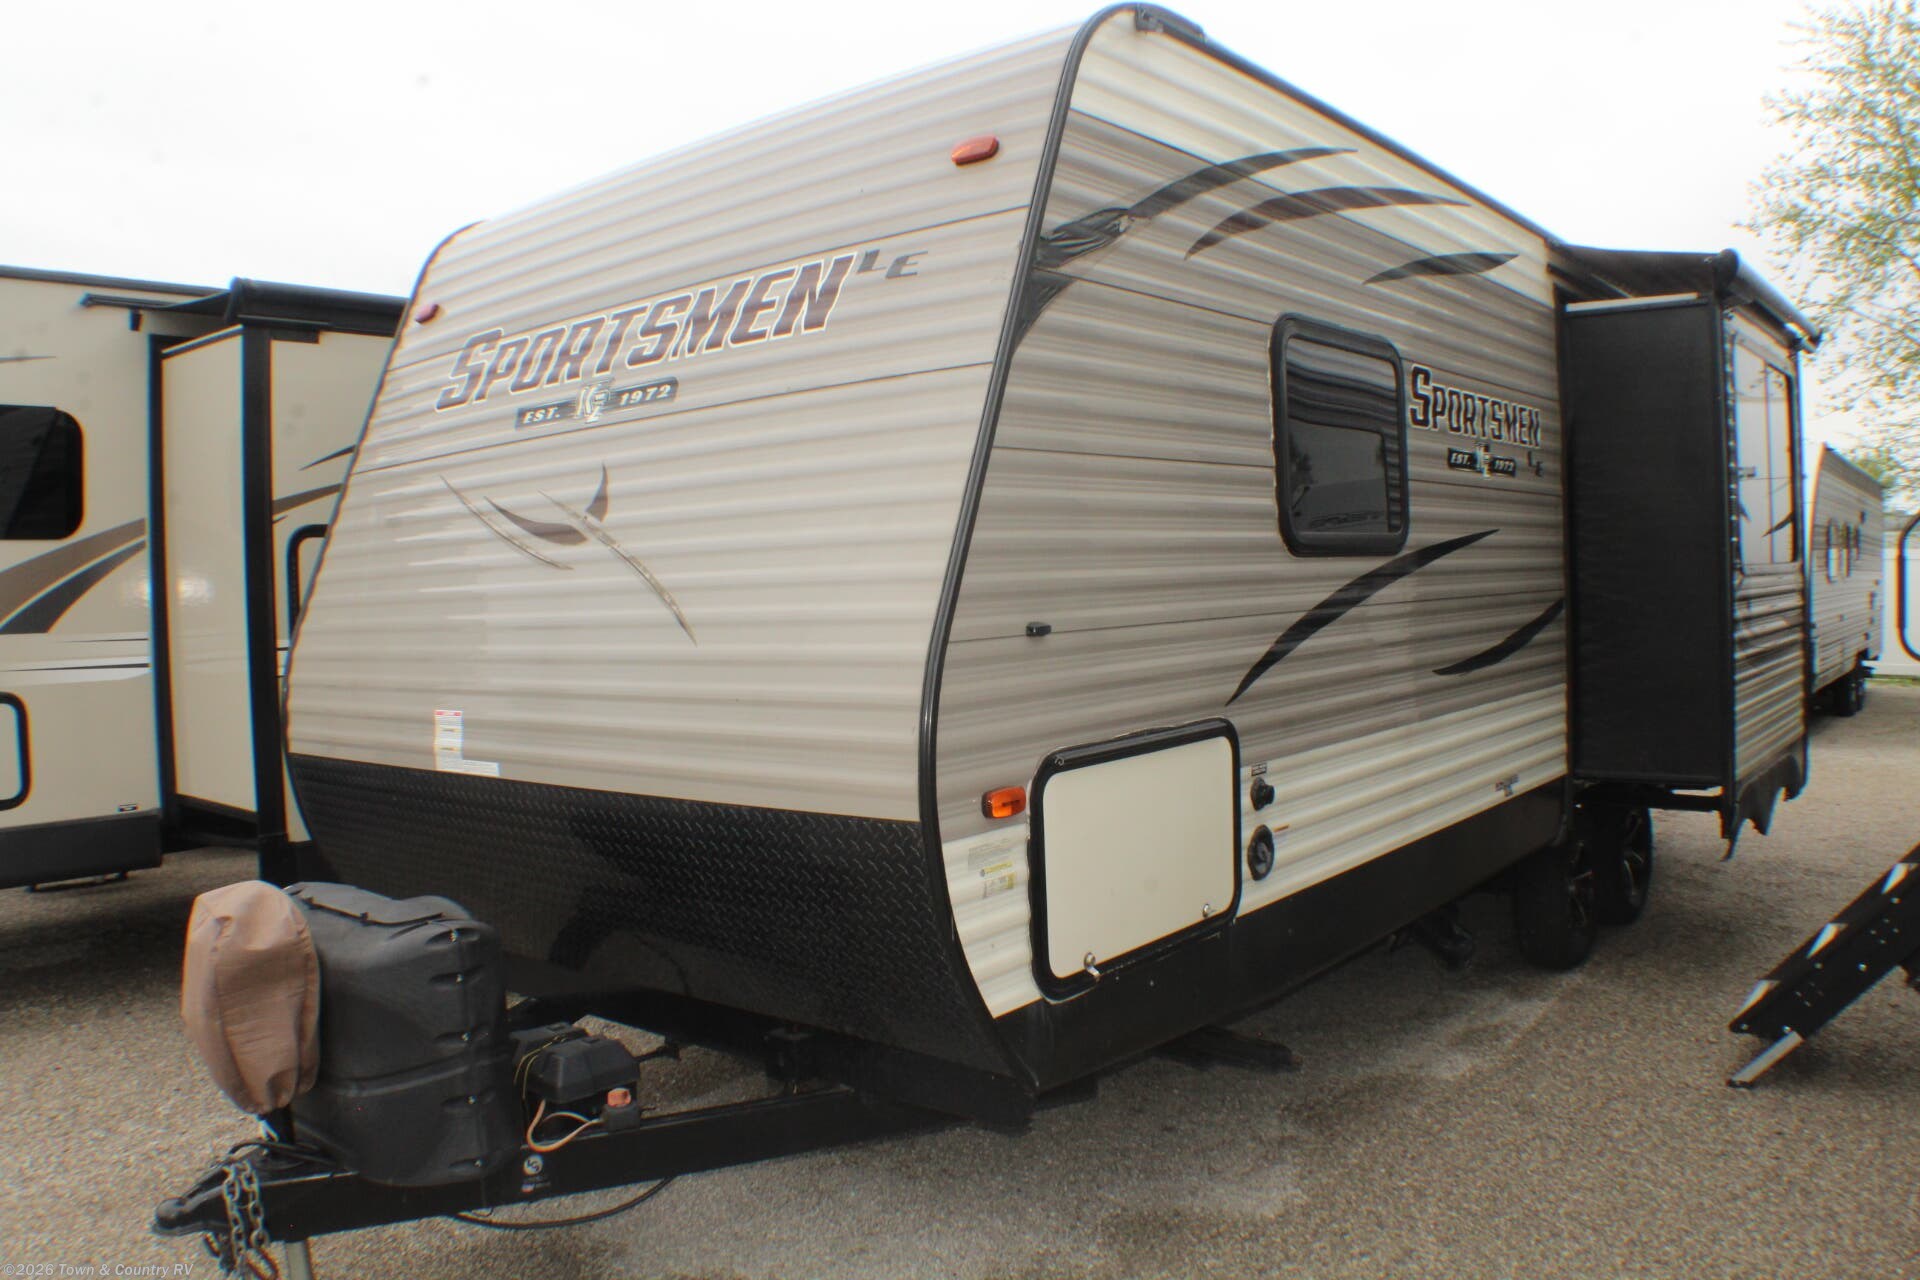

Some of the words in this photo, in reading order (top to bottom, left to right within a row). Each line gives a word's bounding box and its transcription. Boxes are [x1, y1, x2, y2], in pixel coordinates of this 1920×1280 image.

[435, 251, 858, 412] SPORTSMEN
[857, 249, 928, 279] LE
[523, 406, 562, 424] EST.
[619, 384, 672, 406] 1972
[1408, 363, 1541, 449] SPORTSMEN
[1449, 452, 1471, 466] EST.
